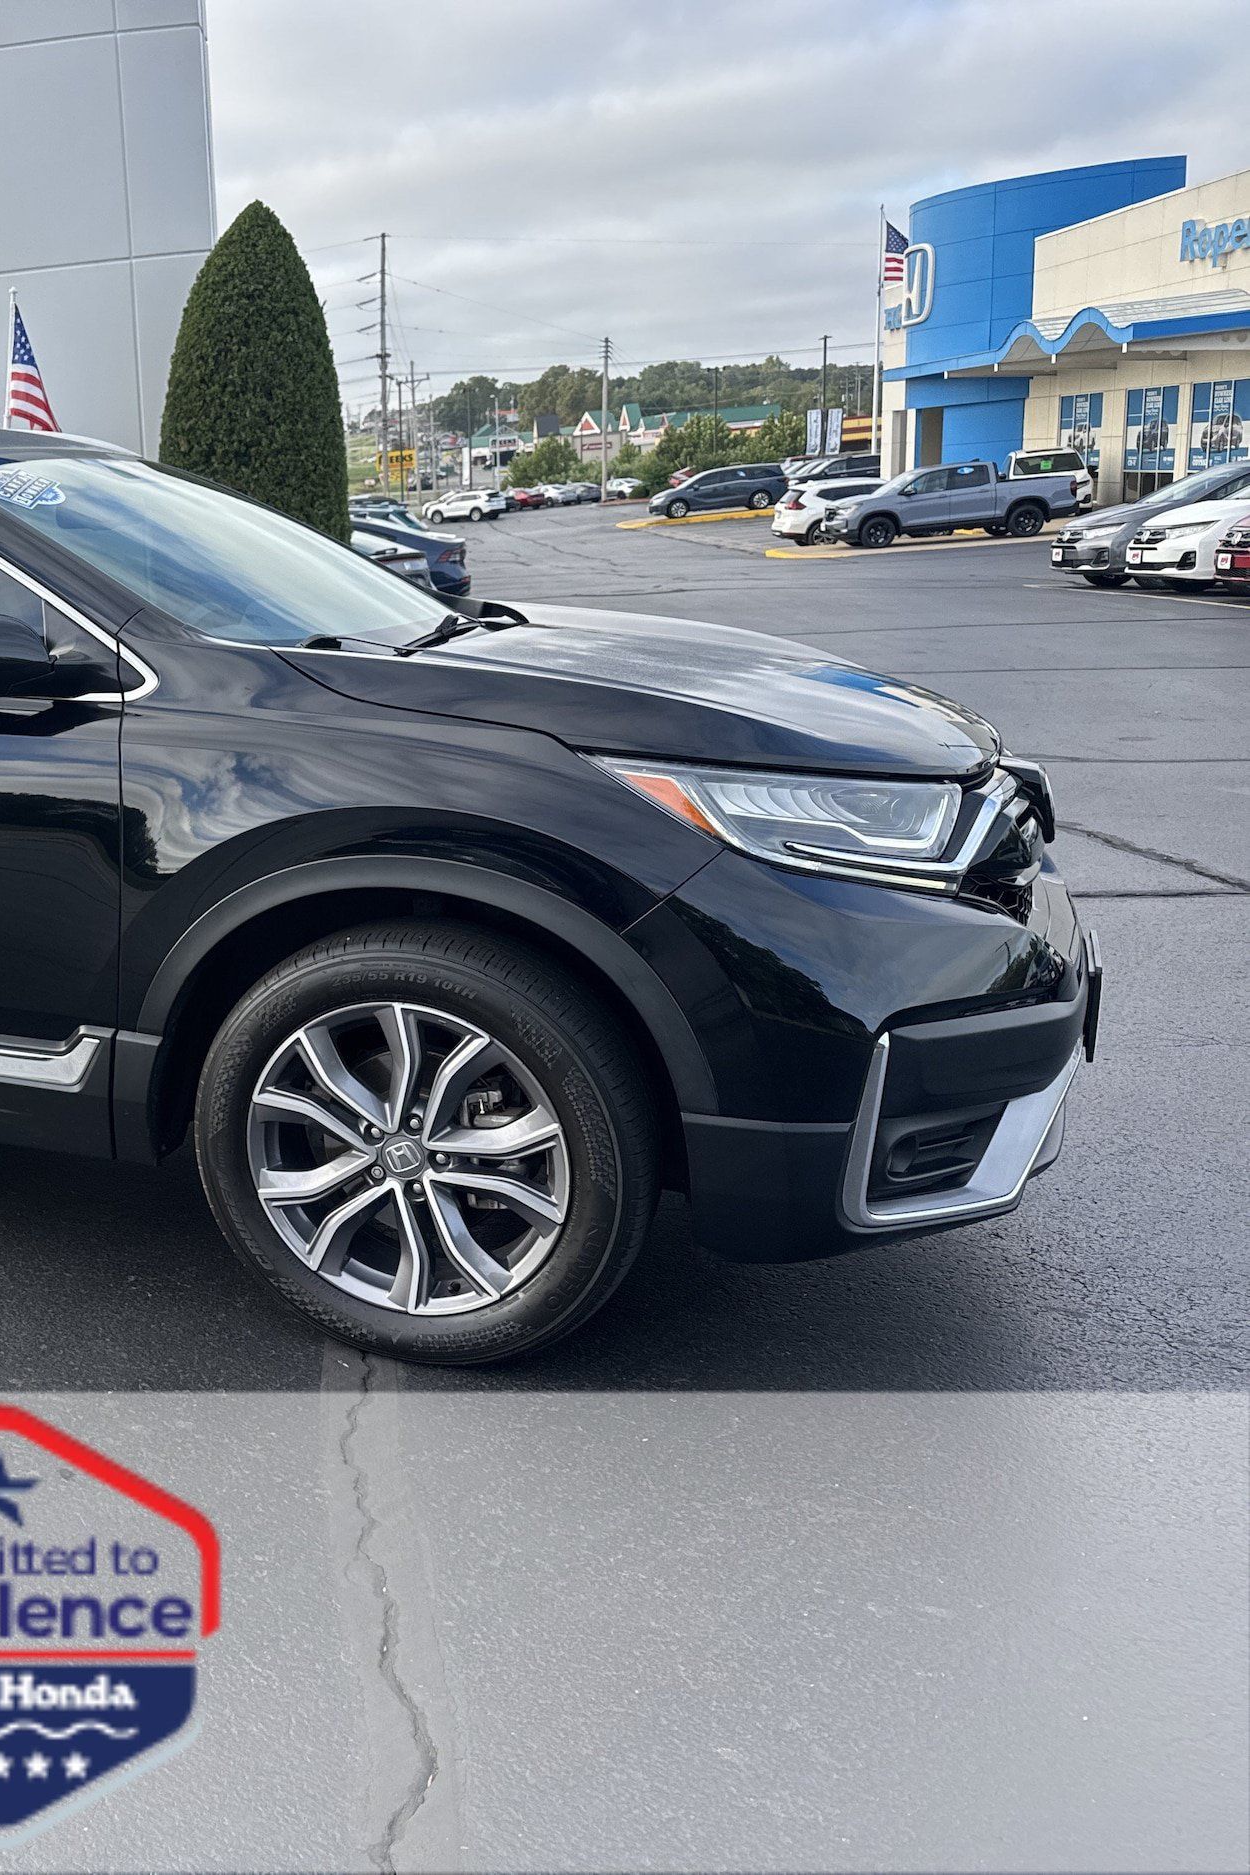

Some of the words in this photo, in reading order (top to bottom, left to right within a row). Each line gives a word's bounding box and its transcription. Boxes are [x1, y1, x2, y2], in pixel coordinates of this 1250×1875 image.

[1180, 217, 1250, 268] Rope
[329, 970, 389, 987] 235/55
[393, 970, 428, 985] R19
[433, 976, 478, 1001] 101H
